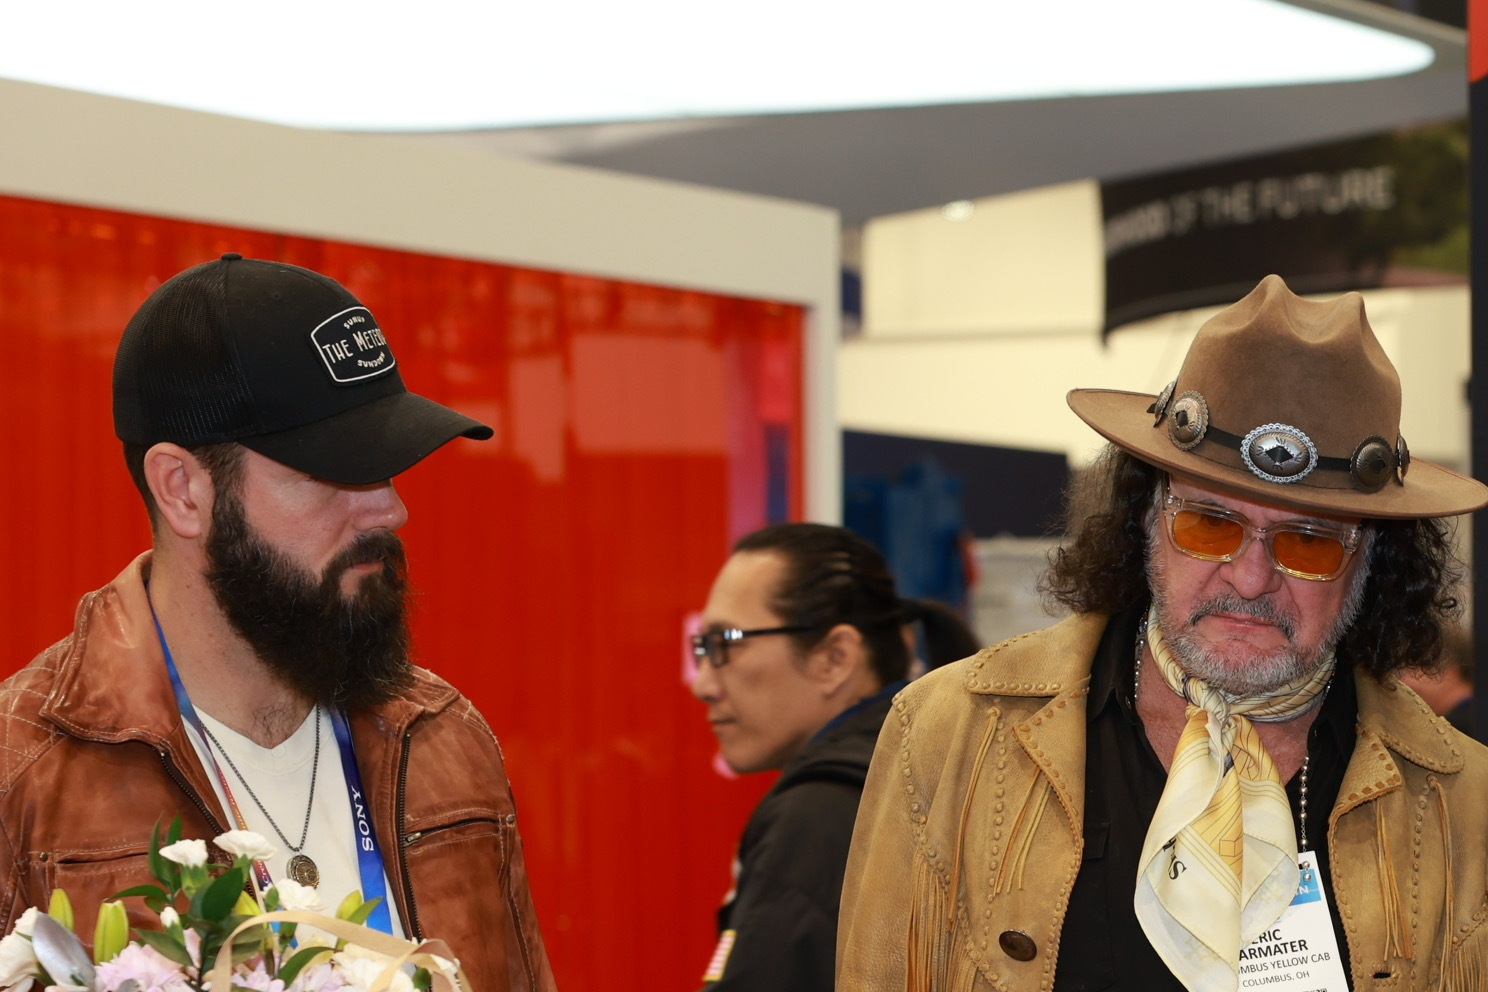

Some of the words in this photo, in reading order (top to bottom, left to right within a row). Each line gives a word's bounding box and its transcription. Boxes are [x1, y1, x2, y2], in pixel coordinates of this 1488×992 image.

[1258, 166, 1394, 218] FUTURE
[322, 339, 354, 364] THE
[351, 785, 375, 852] SONY
[1239, 962, 1269, 975] MBUS
[1270, 955, 1309, 970] YELLOW
[1310, 952, 1331, 964] CAB
[1295, 970, 1310, 980] OH
